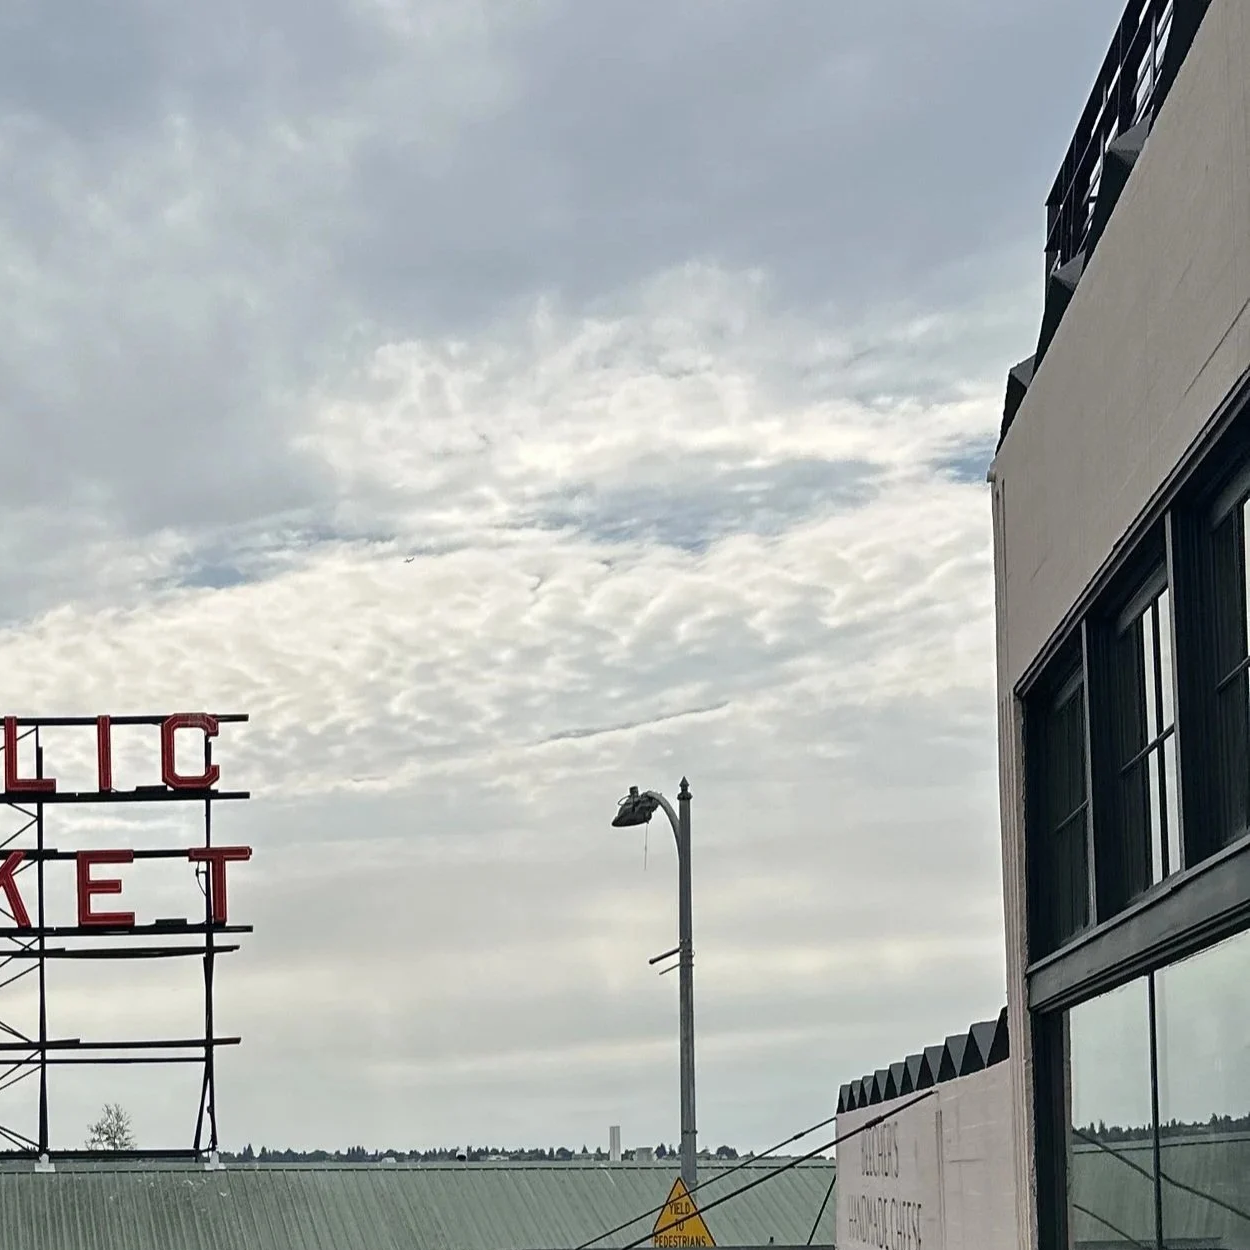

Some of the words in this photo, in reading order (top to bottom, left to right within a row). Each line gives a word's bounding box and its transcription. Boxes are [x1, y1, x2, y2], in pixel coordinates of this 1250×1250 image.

[669, 1202, 691, 1215] YIELD
[675, 1219, 685, 1231] TO
[654, 1235, 707, 1248] PEDESTRIANS
